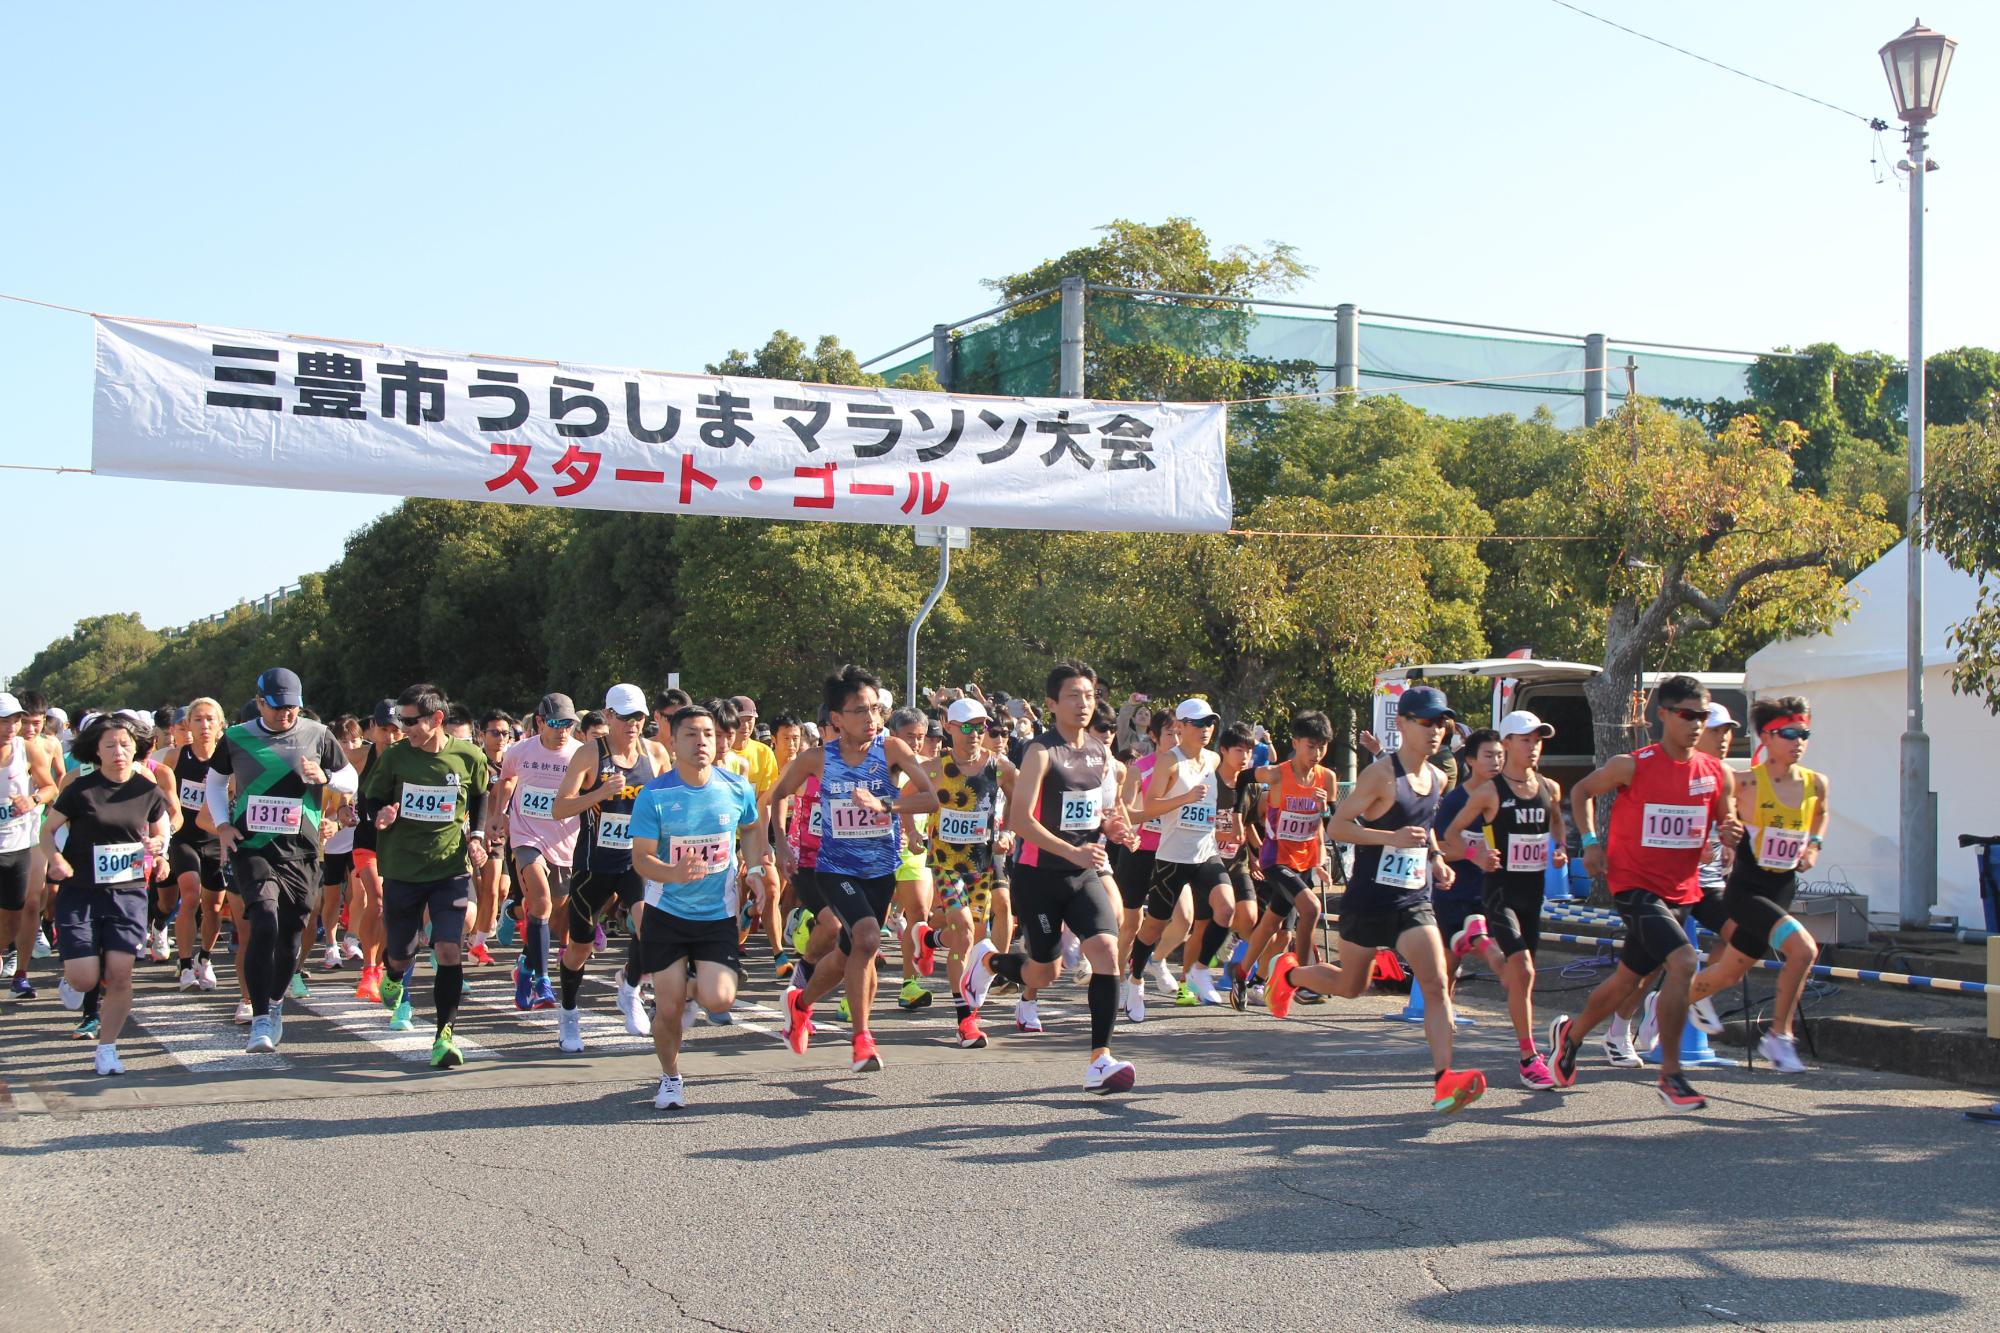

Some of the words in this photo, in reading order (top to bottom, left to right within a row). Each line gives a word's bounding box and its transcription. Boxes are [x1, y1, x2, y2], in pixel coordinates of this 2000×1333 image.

[206, 343, 1157, 472] 三豊市うらしまマラソン大会
[485, 442, 950, 516] スタート・ゴール
[1385, 701, 1401, 754] 四国化
[829, 779, 882, 794] 滋賀県庁
[1513, 843, 1546, 861] 100
[1767, 838, 1804, 858] 100
